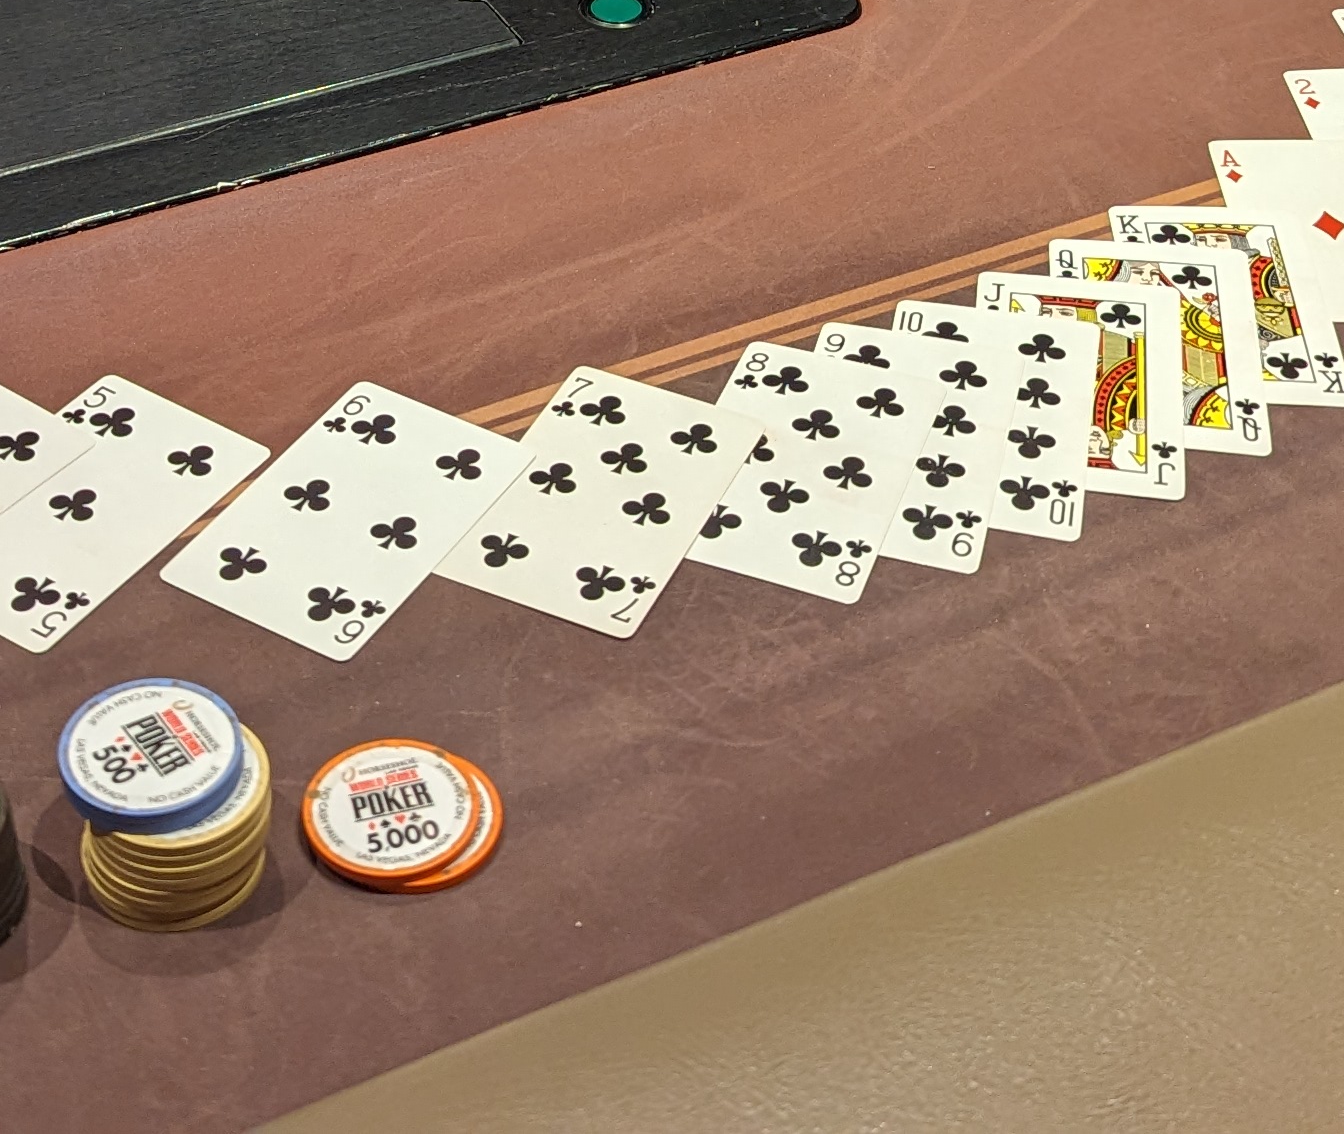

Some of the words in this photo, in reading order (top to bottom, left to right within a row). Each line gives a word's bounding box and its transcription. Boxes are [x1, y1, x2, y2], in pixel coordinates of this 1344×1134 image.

[1294, 79, 1316, 95] 2
[1220, 150, 1242, 167] A
[1116, 215, 1140, 235] K
[1055, 249, 1076, 270] Q
[984, 283, 1006, 303] J
[899, 311, 924, 334] 10
[825, 332, 848, 354] 9
[744, 352, 771, 373] 8
[82, 385, 117, 409] 5
[565, 376, 595, 399] 7
[343, 394, 372, 417] 6
[1236, 416, 1262, 442] Q
[1153, 462, 1176, 487] J
[1049, 498, 1076, 528] 10
[834, 560, 862, 587] 8
[611, 597, 639, 623] 7
[30, 610, 68, 640] 5
[126, 715, 192, 778] POKER
[92, 743, 137, 784] 500
[146, 792, 169, 804] NO
[170, 785, 198, 801] CASH
[350, 781, 434, 819] POKER
[367, 819, 440, 854] 5,000
